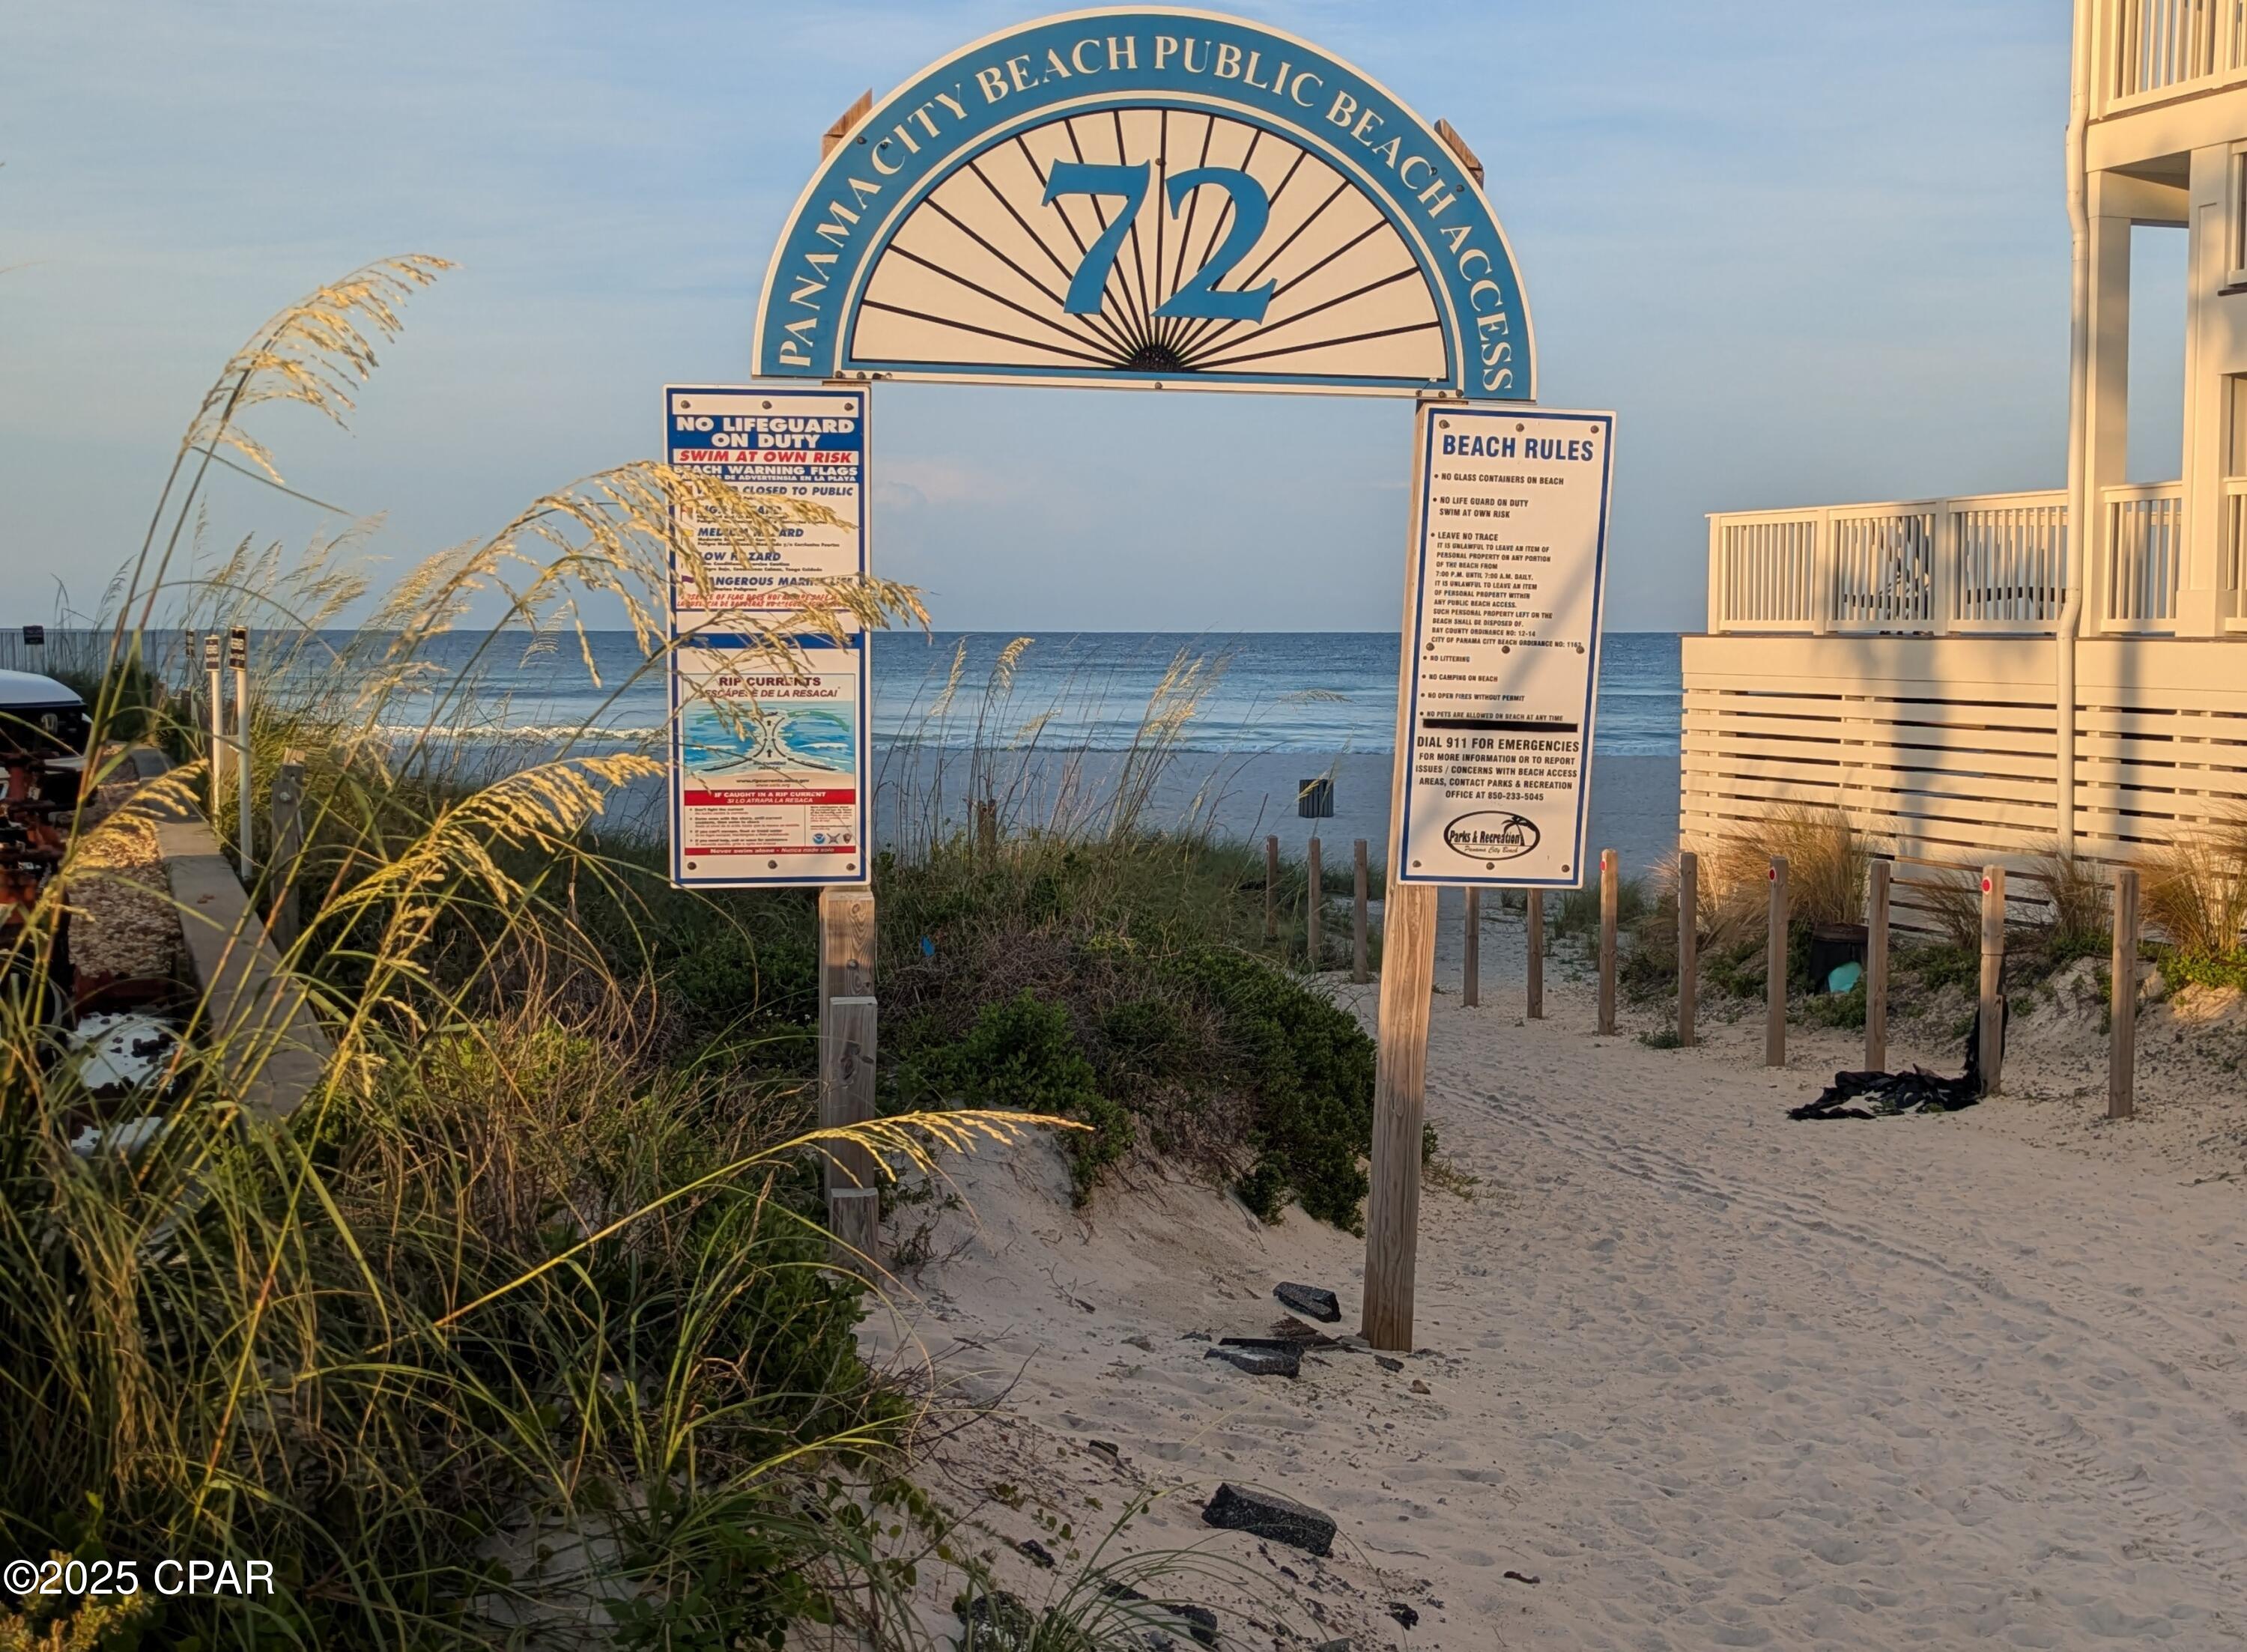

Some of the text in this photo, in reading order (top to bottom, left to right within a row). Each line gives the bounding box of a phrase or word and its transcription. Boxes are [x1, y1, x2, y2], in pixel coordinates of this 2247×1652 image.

[778, 35, 1514, 392] PANAMA CITY BEACH PUBLIC BEACH ACCESS
[1040, 157, 1278, 326] 72
[676, 416, 855, 434] NO LIFEGUARD
[712, 434, 821, 449] ON DUTY
[1442, 434, 1594, 461] BEACH RULES
[679, 450, 852, 464] SWIM AT OWN RISK
[727, 466, 805, 475] WARNING
[810, 467, 858, 476] FLAGS
[1453, 473, 1476, 482] GLASS
[1478, 474, 1525, 483] CONTAINERS
[1526, 476, 1537, 484] ON
[1538, 476, 1564, 485] BEACH
[743, 486, 787, 494] CLOSED
[792, 487, 807, 495] TO
[812, 487, 853, 496] PUBLIC
[1440, 496, 1529, 507] NO LIFE GUARD ON DUTY
[1439, 508, 1510, 518] SWIM AT OWN RISK
[1437, 531, 1498, 541] LEAVE NO TRACE
[719, 677, 821, 686] RIP CURRENTS
[1416, 735, 1580, 752] DIAL 911 FOR EMERGENCIES
[1419, 752, 1575, 765] FOR MORE INFORMATION OR TO REPORT
[1415, 765, 1443, 773] ISSUES
[1451, 765, 1493, 774] CONCERNS
[1495, 767, 1515, 775] WITH
[1517, 768, 1544, 776] BEACH
[1546, 768, 1577, 777] ACCESS
[1419, 777, 1572, 789] AREAS, CONTACT PARKS & RECREATION
[1445, 790, 1544, 801] OFFICE AT 850-233-5045
[1450, 830, 1521, 844] Parks & Recreation
